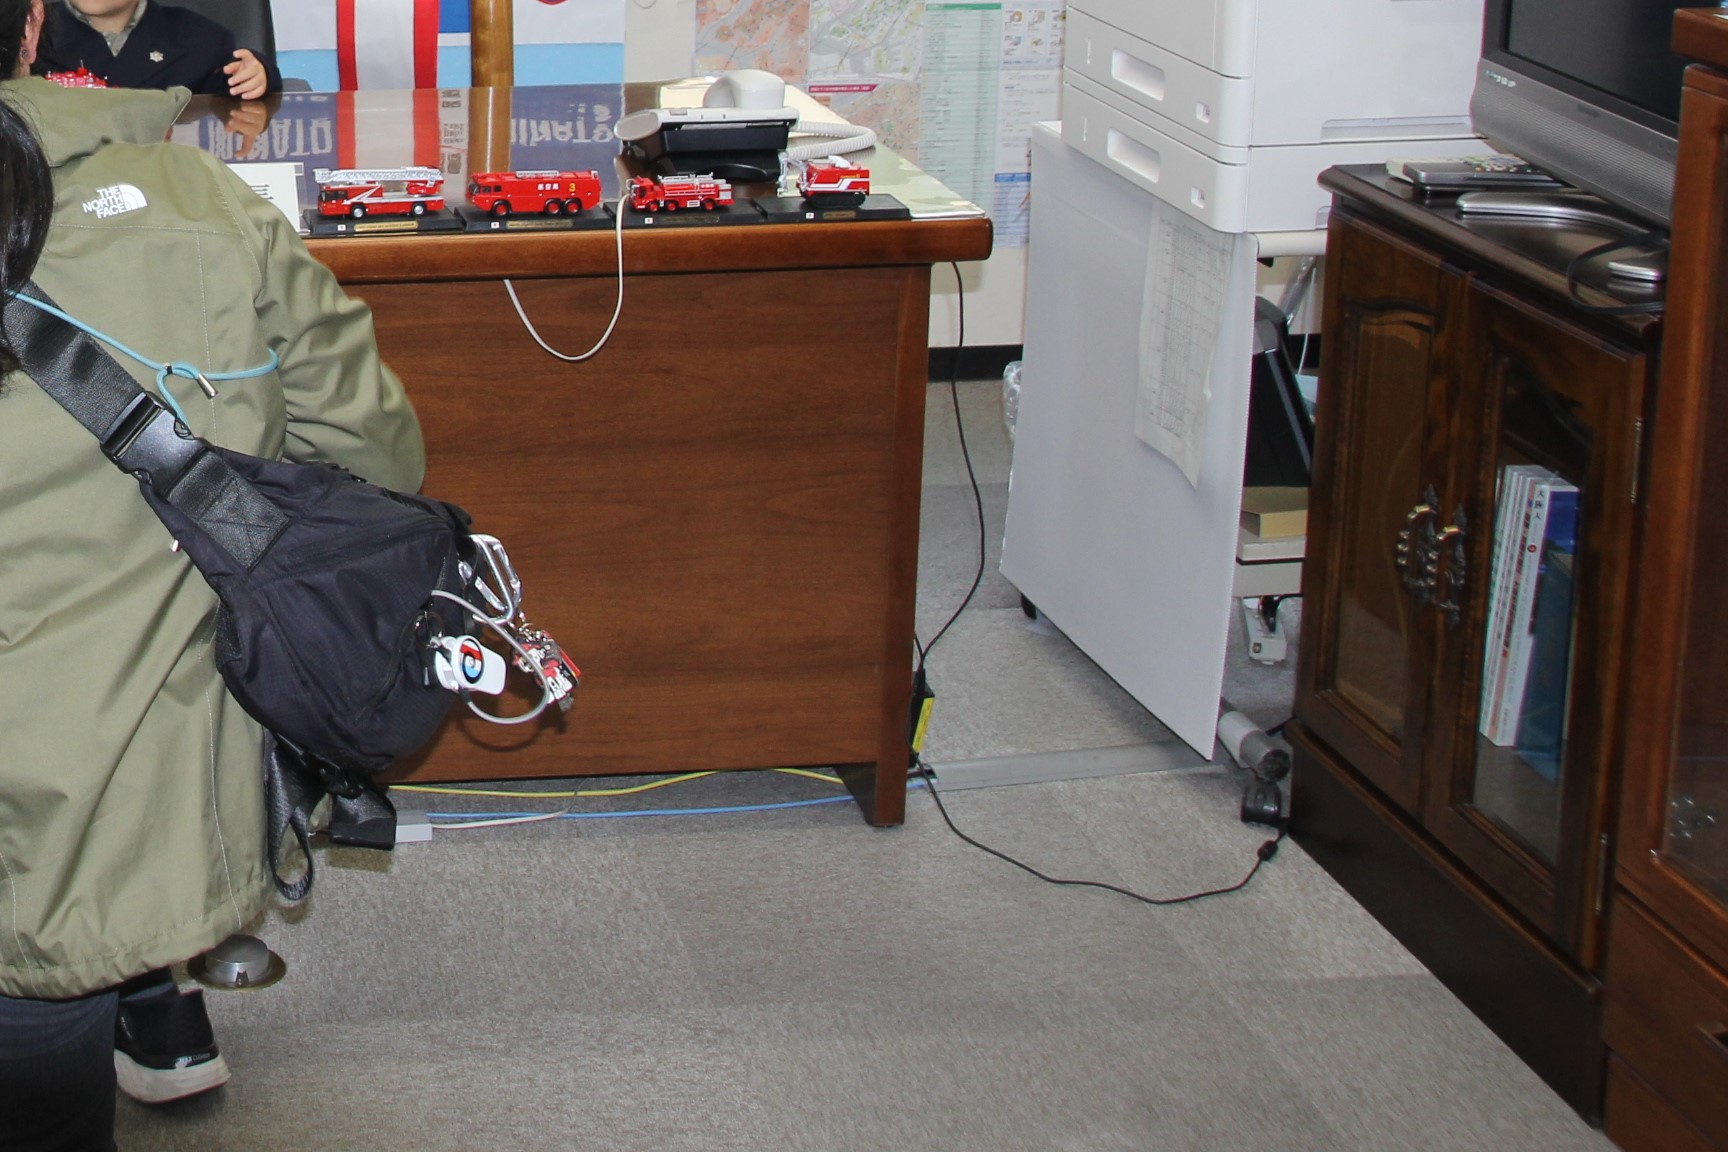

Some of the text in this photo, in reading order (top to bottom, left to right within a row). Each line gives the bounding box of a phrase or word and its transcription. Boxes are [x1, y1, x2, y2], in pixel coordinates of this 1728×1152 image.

[96, 185, 120, 199] THE
[569, 182, 576, 193] 3
[82, 194, 123, 214] NORTH
[96, 203, 127, 219] FACE
